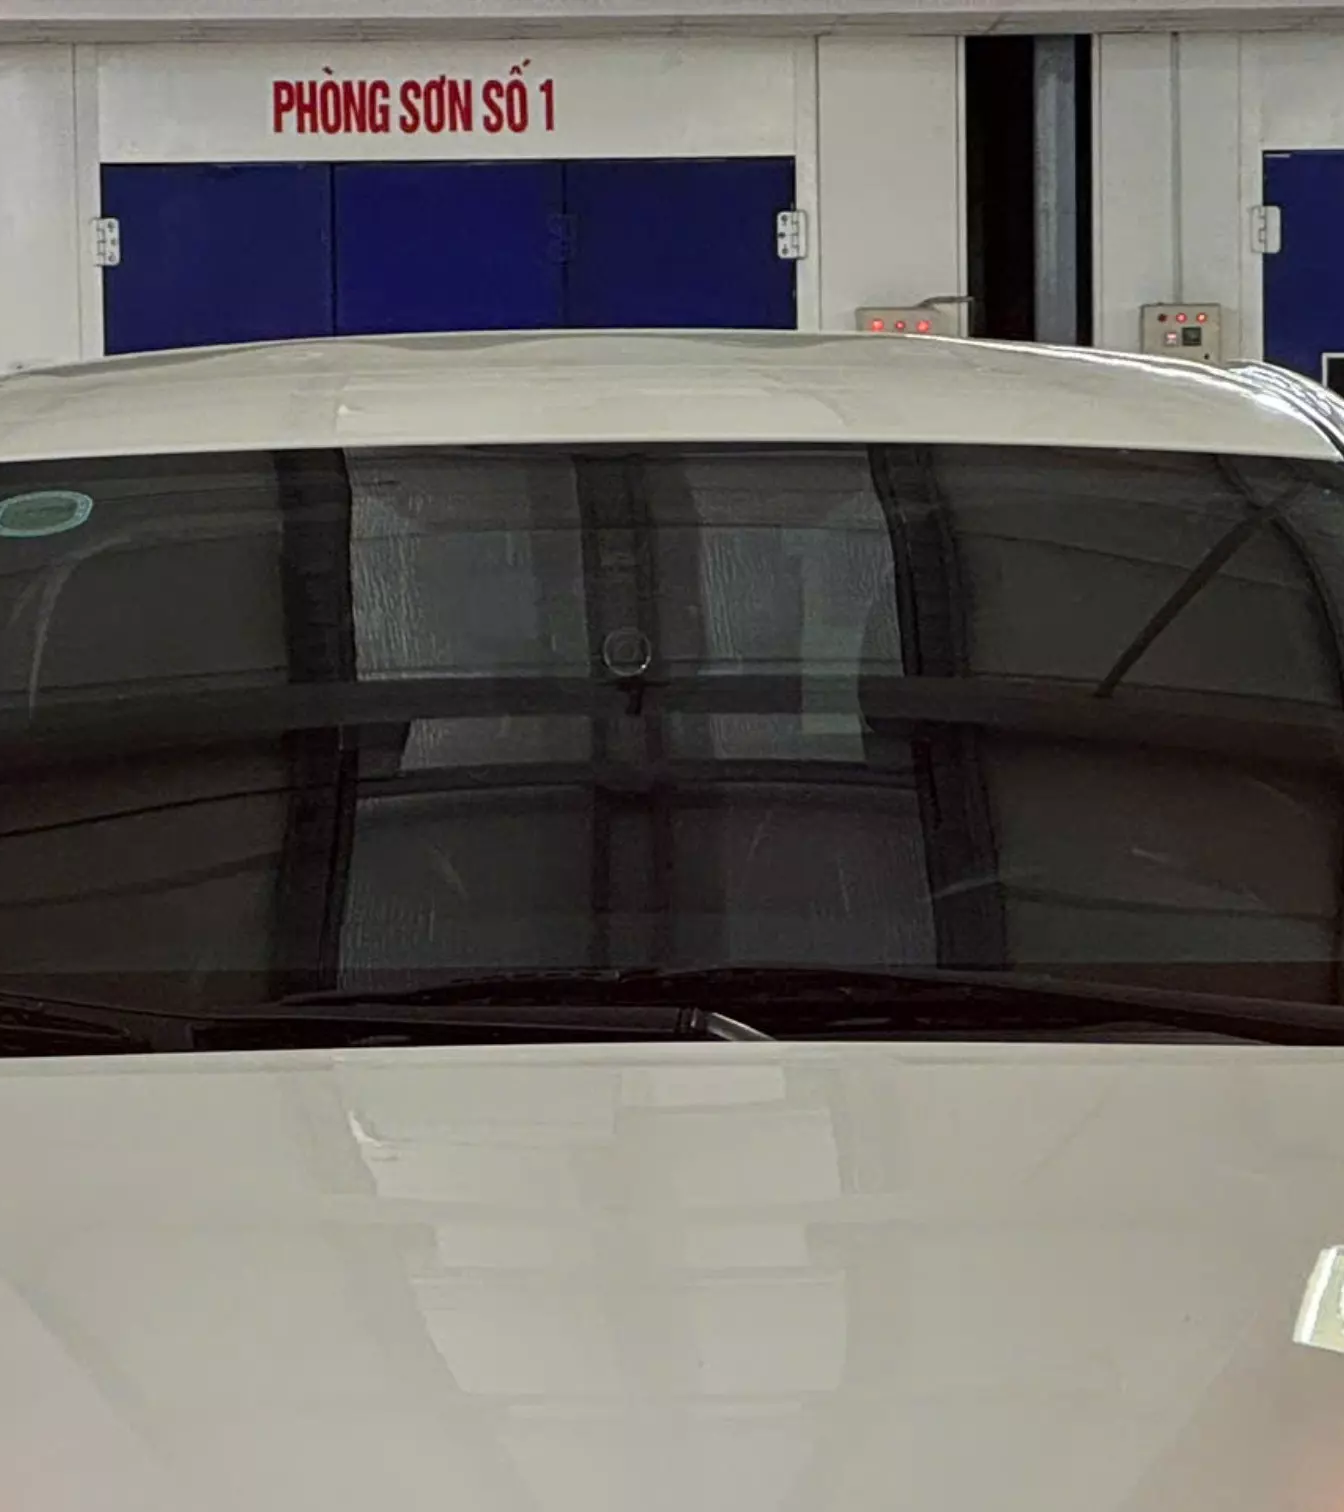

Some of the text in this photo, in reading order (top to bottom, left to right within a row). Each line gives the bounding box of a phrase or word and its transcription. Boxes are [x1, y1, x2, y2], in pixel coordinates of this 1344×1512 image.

[272, 58, 555, 134] PHÒNG SƠN SỐ 1
